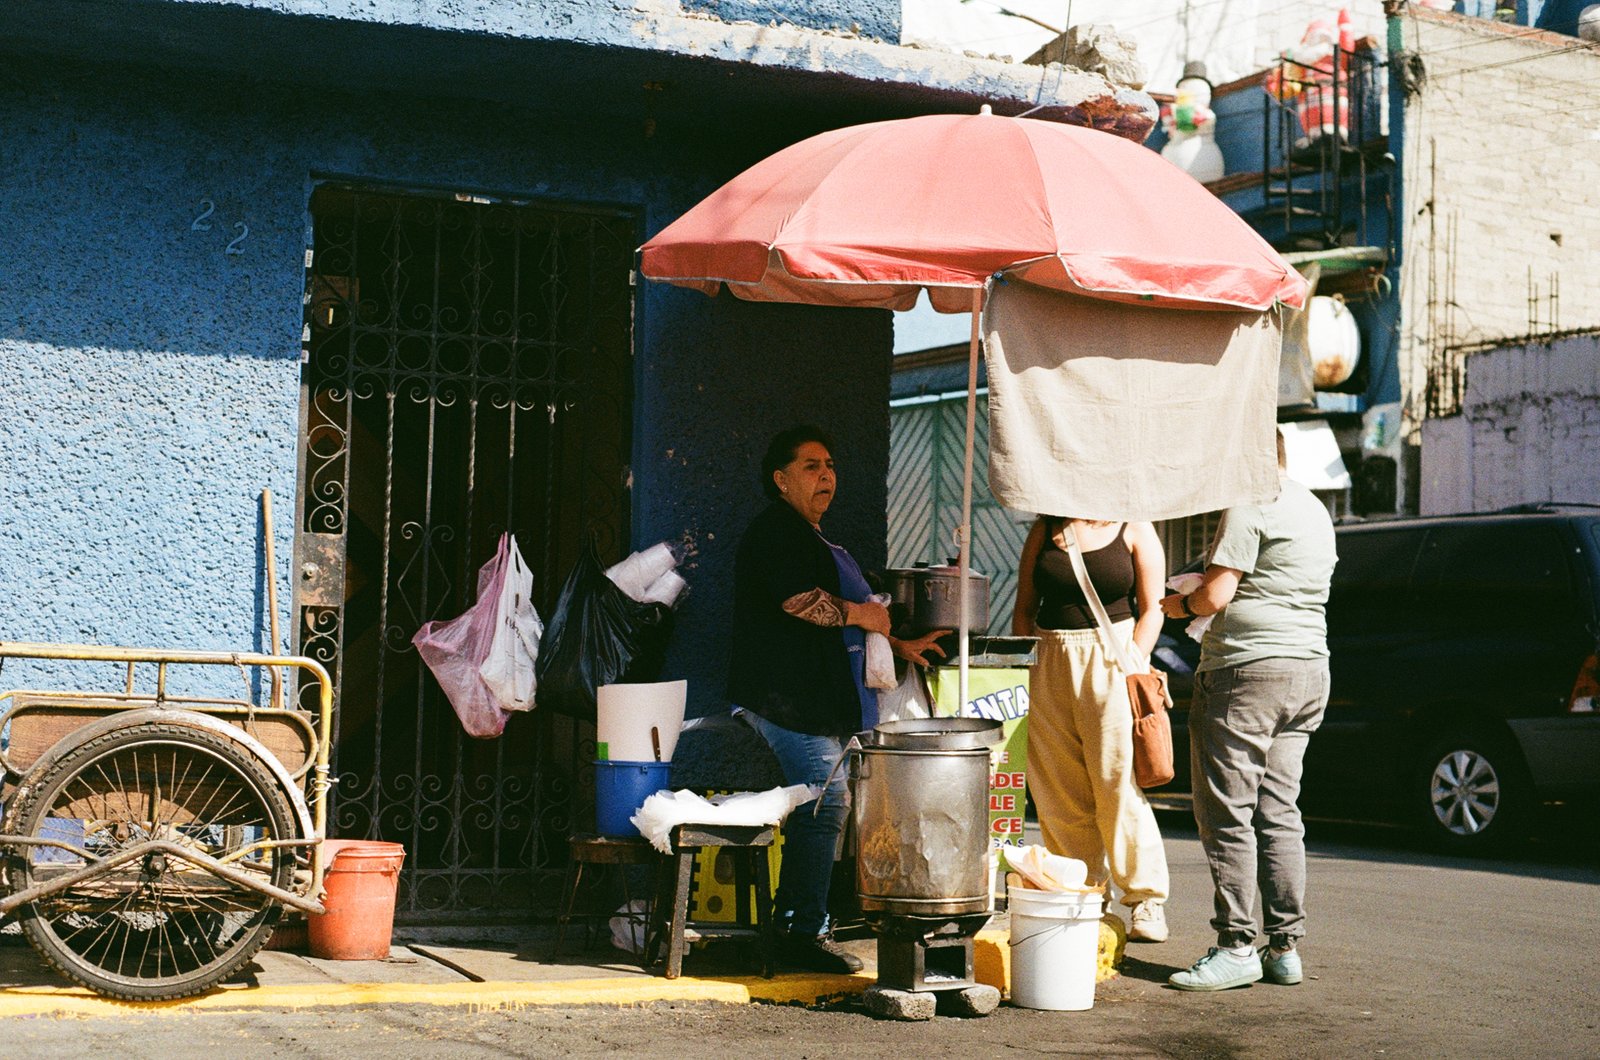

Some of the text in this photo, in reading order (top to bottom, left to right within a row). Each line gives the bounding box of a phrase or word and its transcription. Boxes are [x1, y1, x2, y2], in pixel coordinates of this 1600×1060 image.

[191, 199, 249, 255] 22
[956, 684, 1030, 722] ENTA
[990, 771, 1026, 789] DE
[989, 794, 1015, 812] LE
[990, 816, 1022, 834] CE
